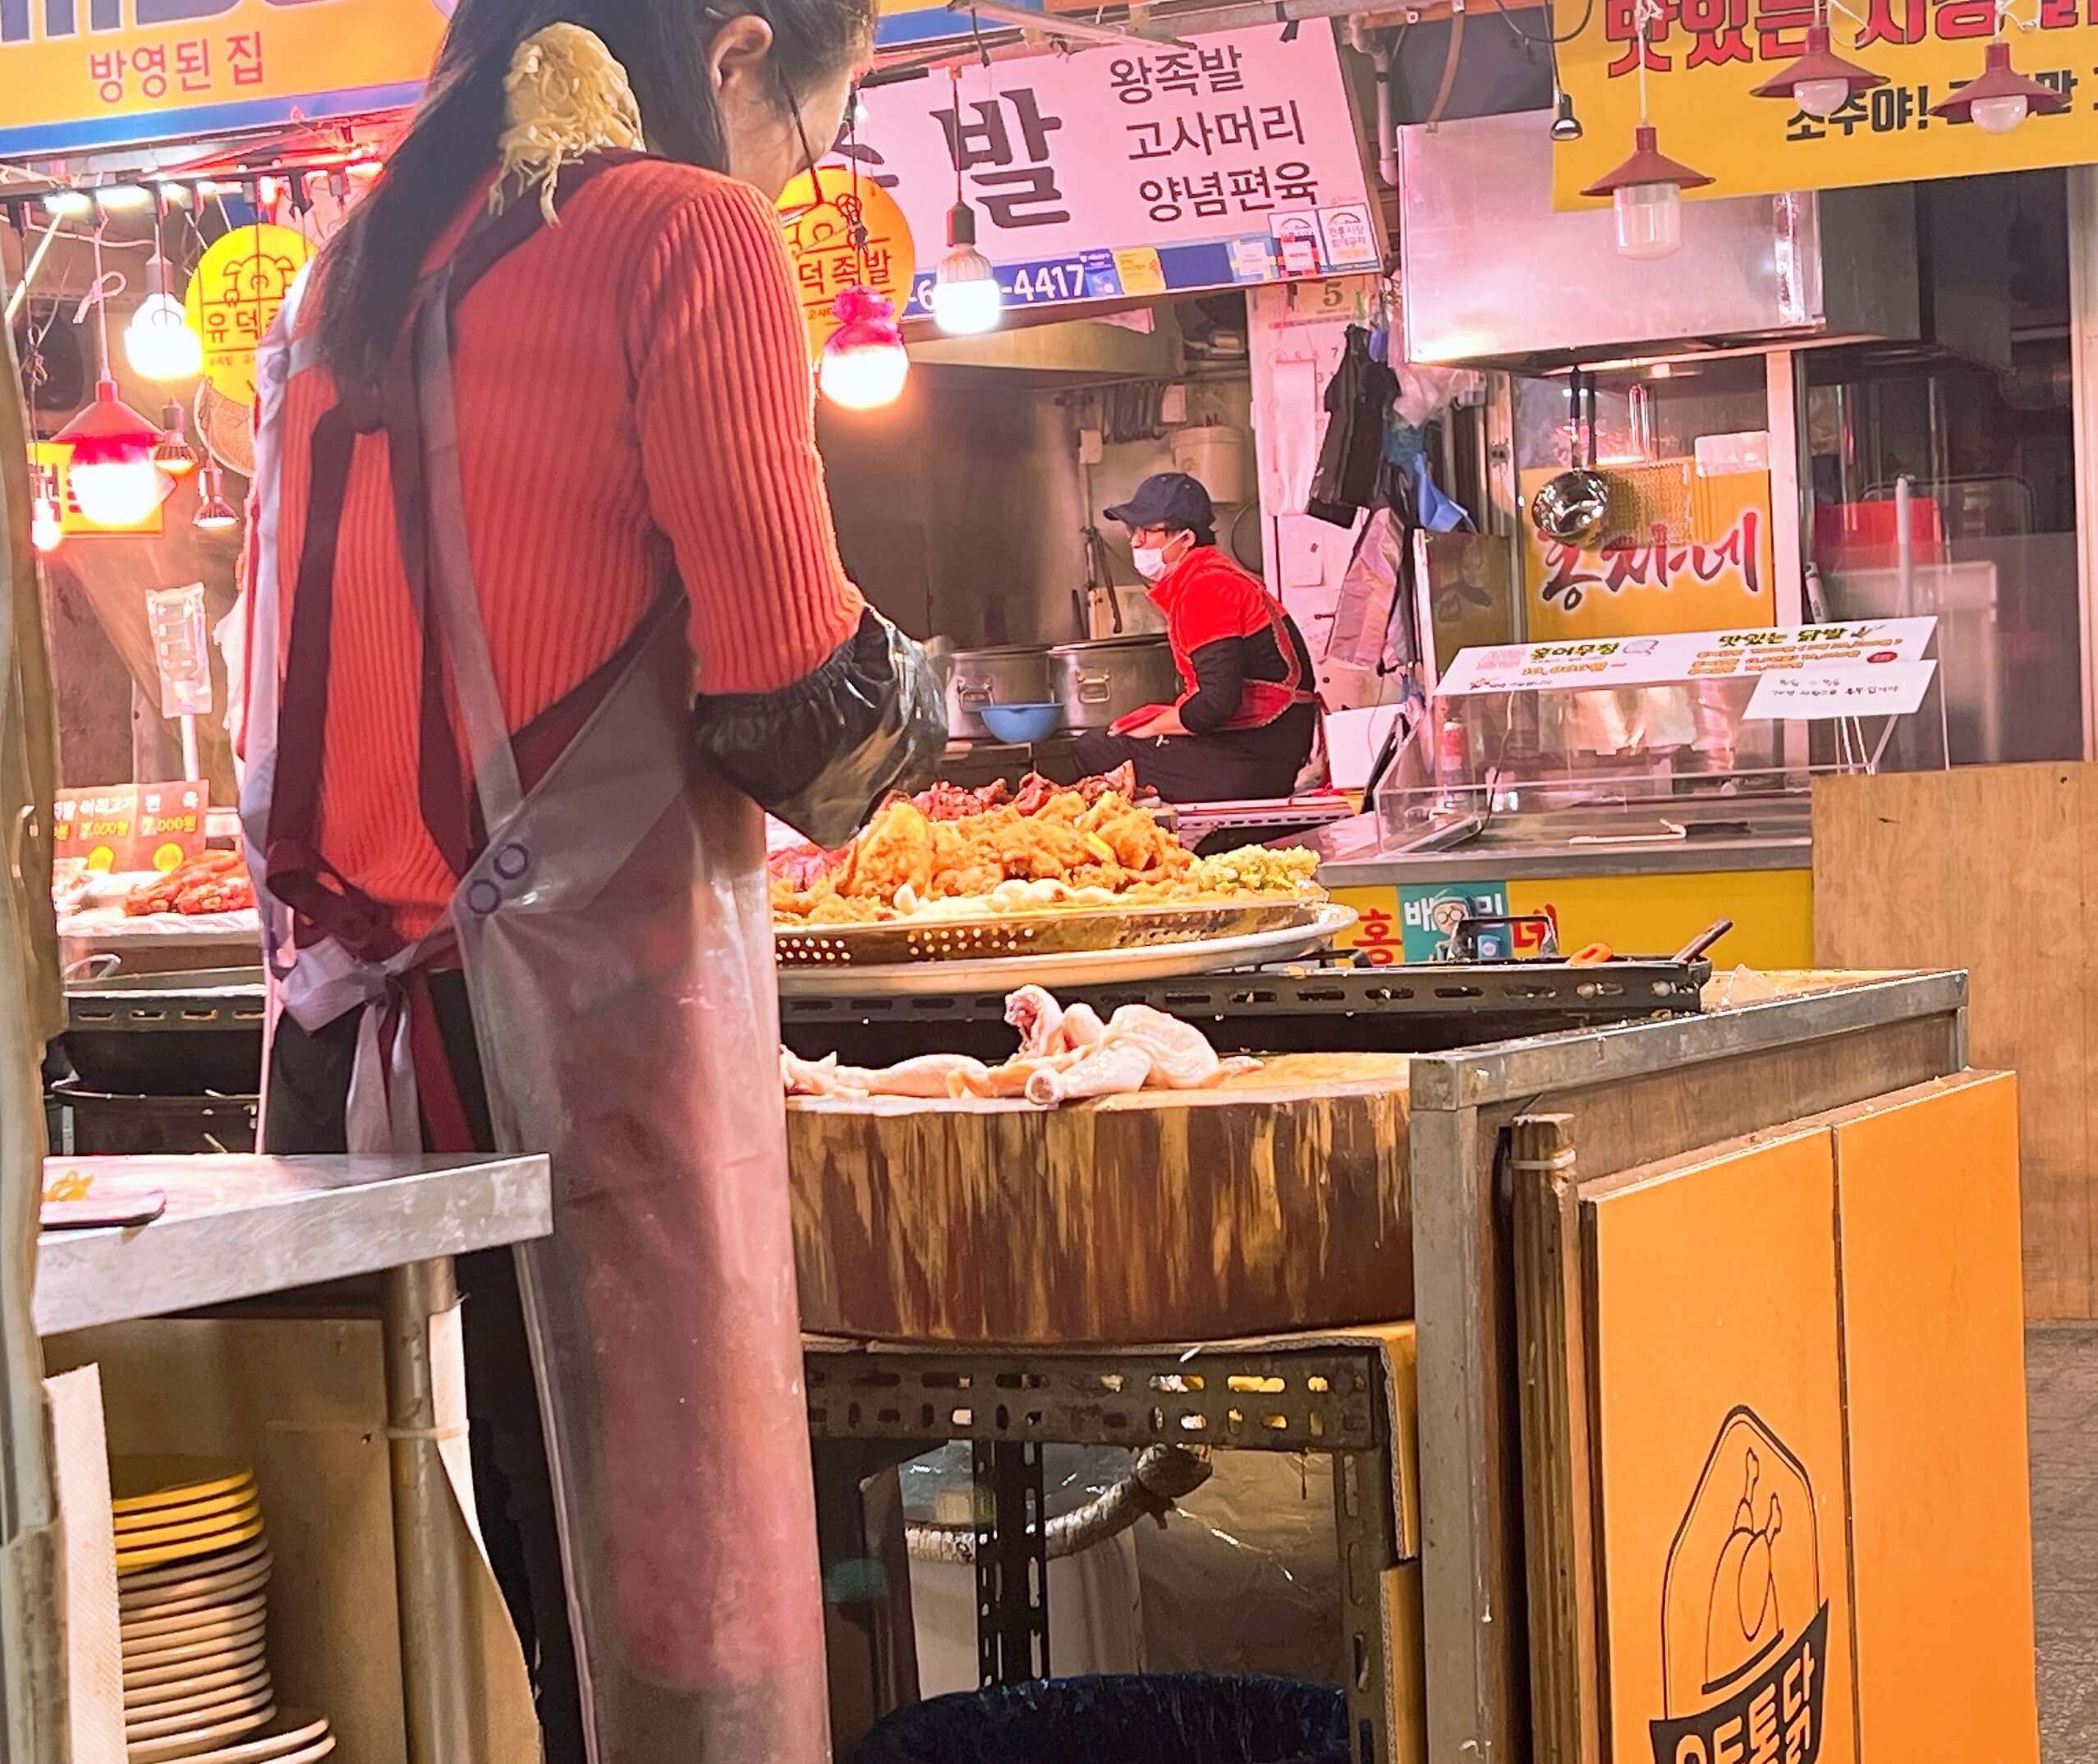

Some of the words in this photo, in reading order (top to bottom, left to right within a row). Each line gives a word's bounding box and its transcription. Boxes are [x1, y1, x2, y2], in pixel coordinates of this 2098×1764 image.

[90, 38, 211, 104] 방영된
[227, 31, 264, 86] 집
[1109, 44, 1245, 104] 왕족발
[1126, 99, 1306, 160] 고사머리
[1139, 161, 1319, 223] 양념편육
[1323, 282, 1343, 307] 5
